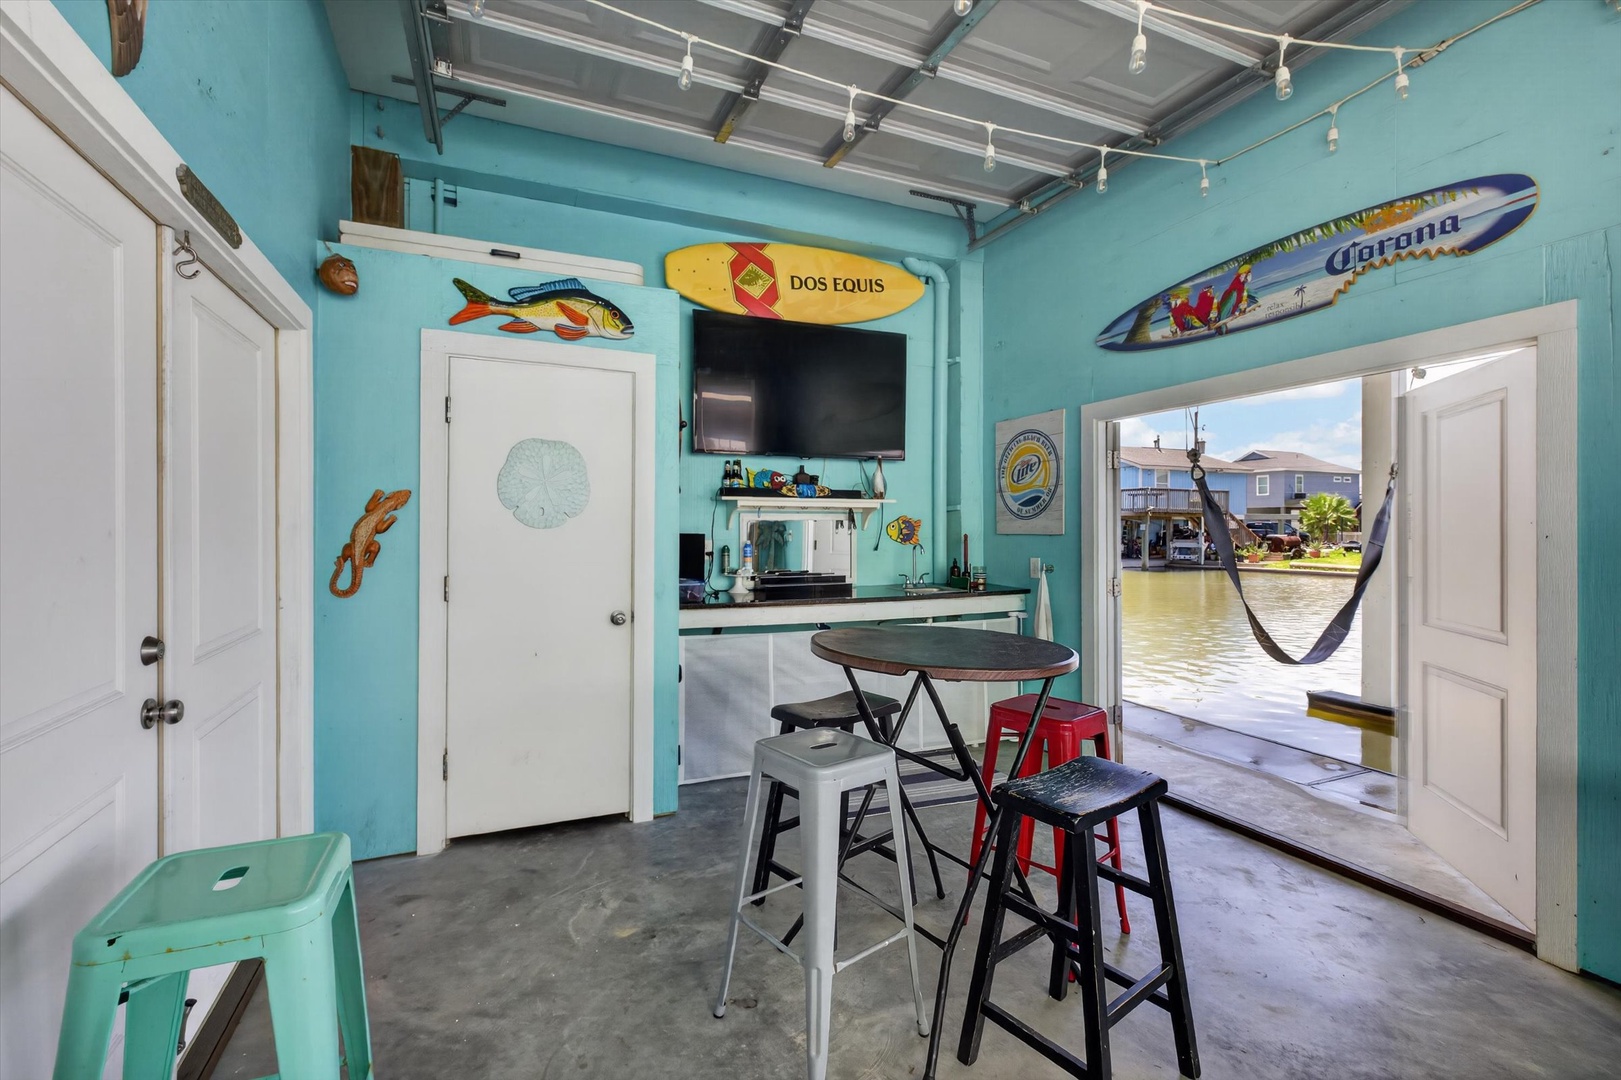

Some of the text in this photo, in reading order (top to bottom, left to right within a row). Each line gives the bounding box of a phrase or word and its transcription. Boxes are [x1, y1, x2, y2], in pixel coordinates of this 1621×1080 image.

[1324, 214, 1462, 276] Corona
[790, 275, 885, 293] DOS EQUIS
[1266, 302, 1285, 312] relax
[1016, 461, 1038, 483] Lite
